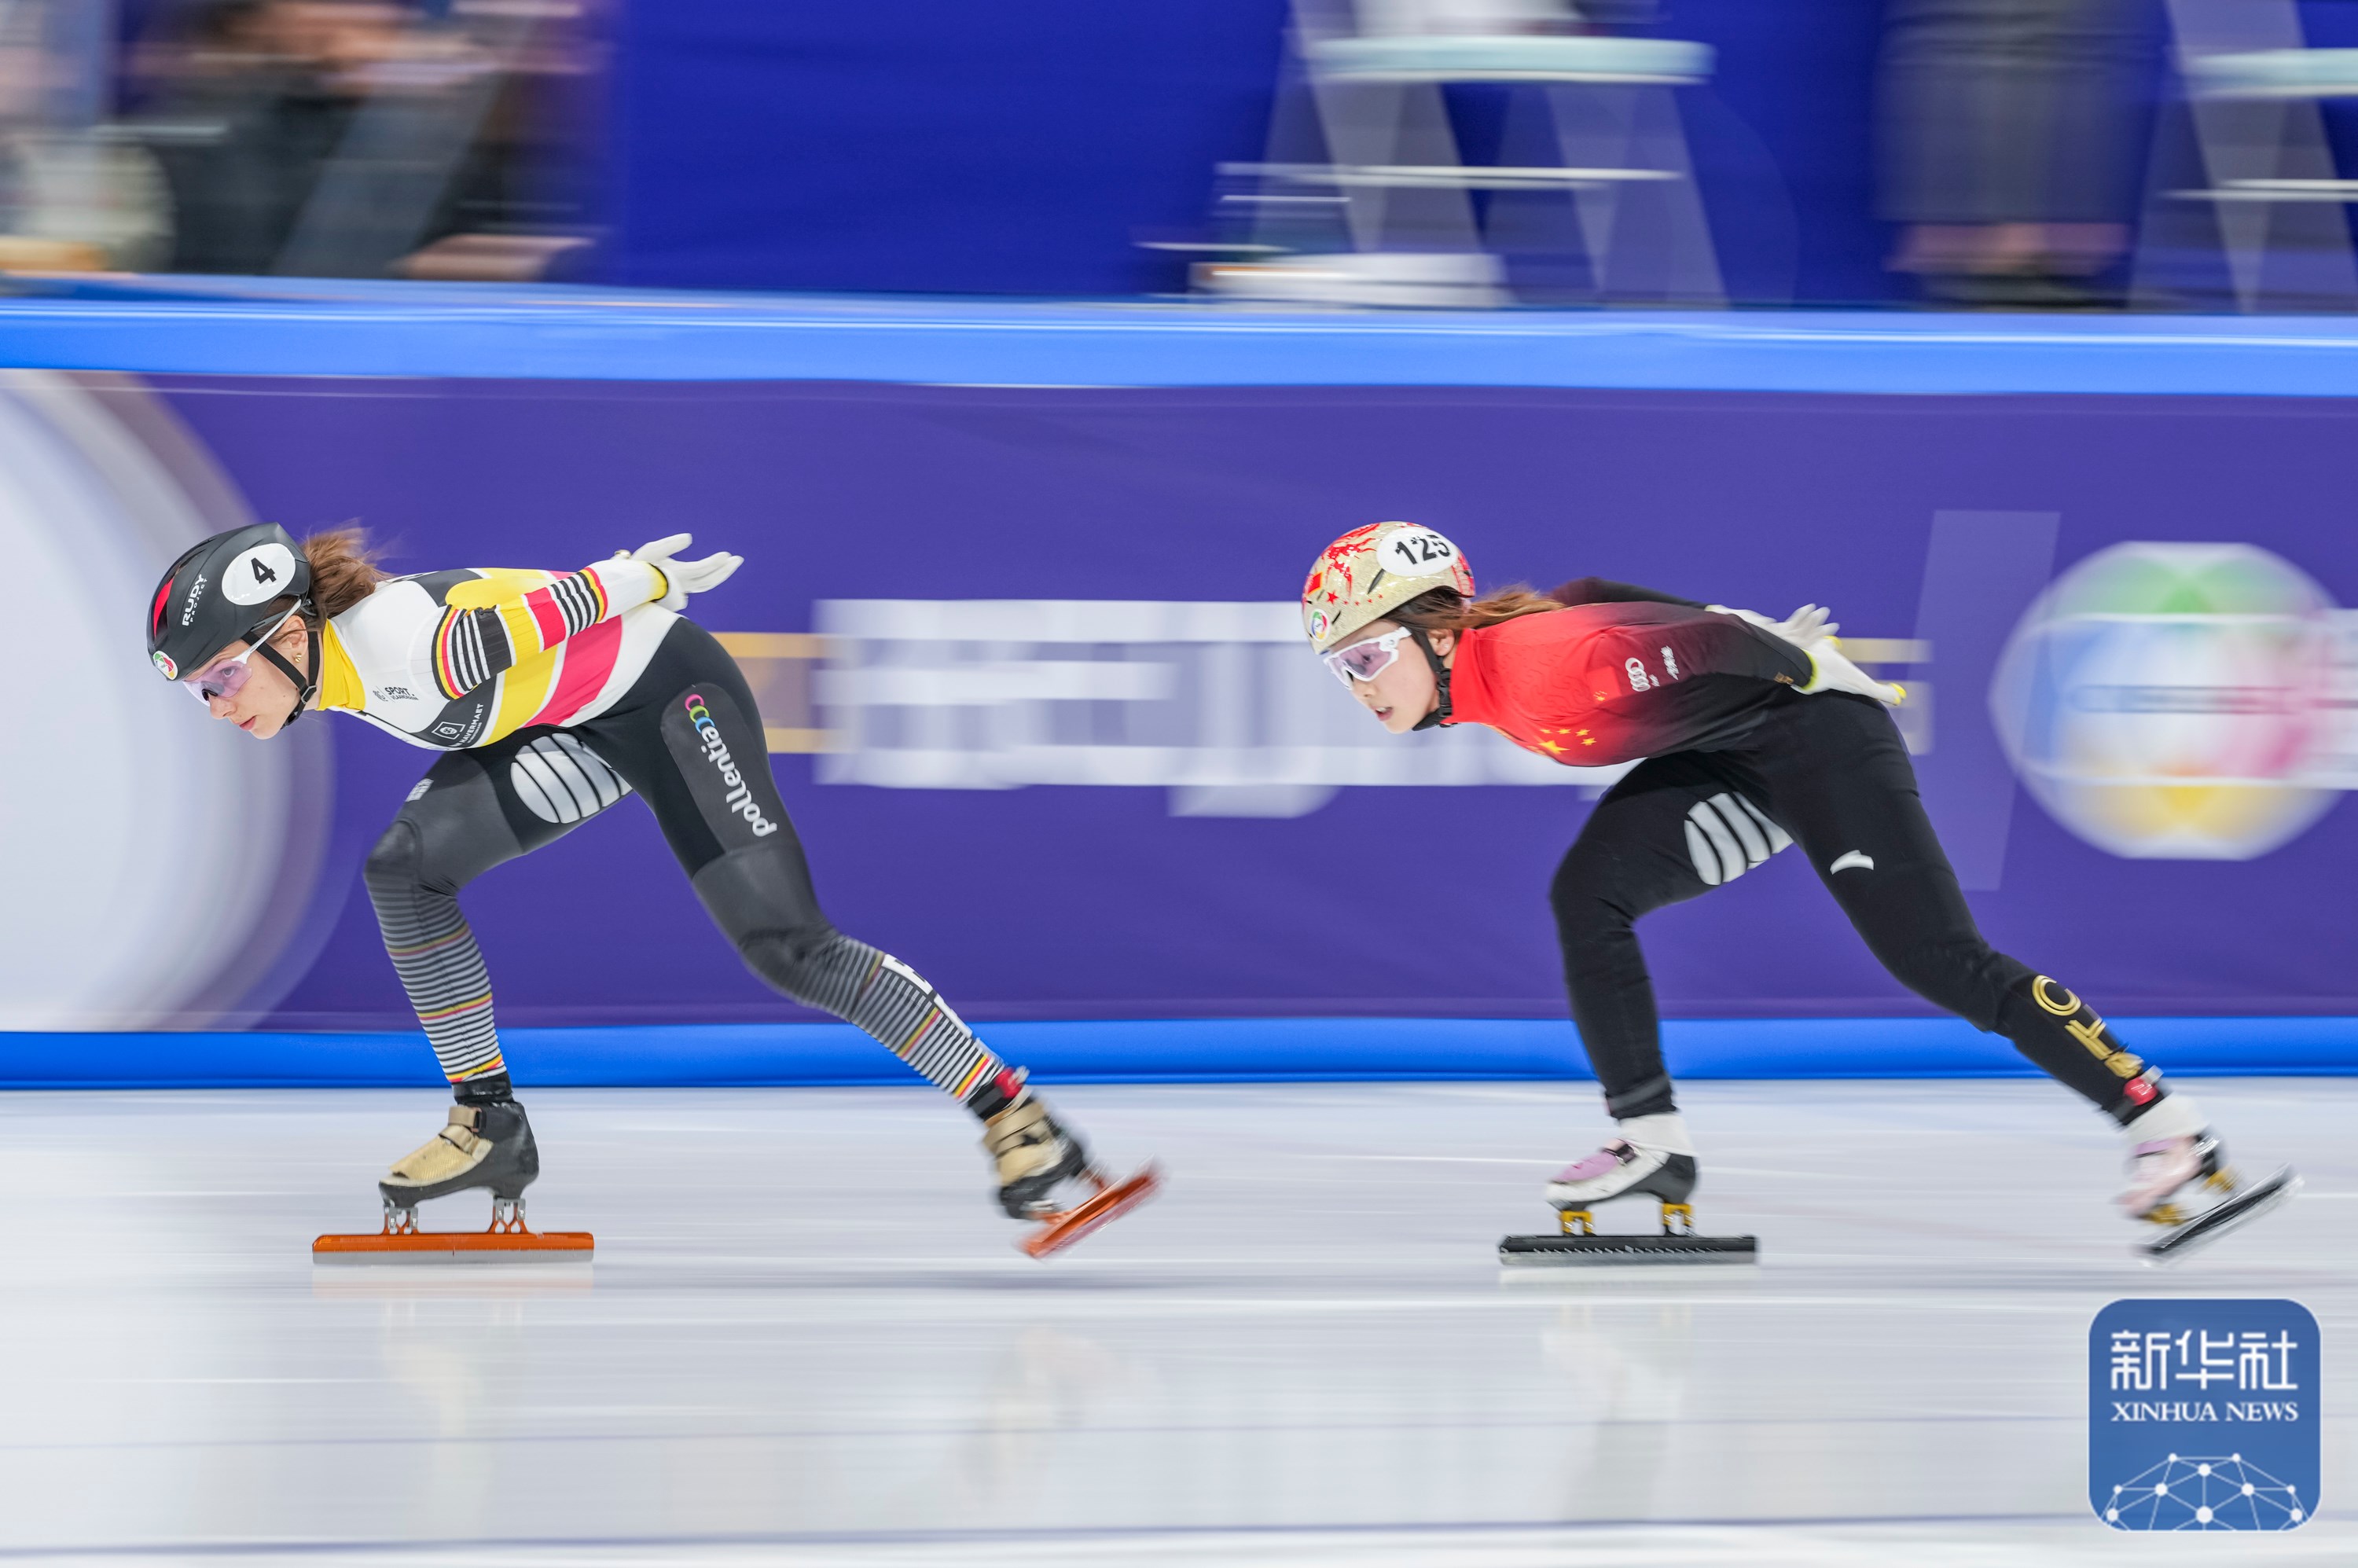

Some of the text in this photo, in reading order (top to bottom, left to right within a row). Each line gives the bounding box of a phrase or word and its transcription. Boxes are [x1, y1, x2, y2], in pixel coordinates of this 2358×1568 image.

[250, 556, 277, 585] 4
[1394, 534, 1451, 565] 125
[182, 574, 204, 626] RUDY
[189, 578, 208, 622] PROJECT
[700, 725, 778, 838] pollentia
